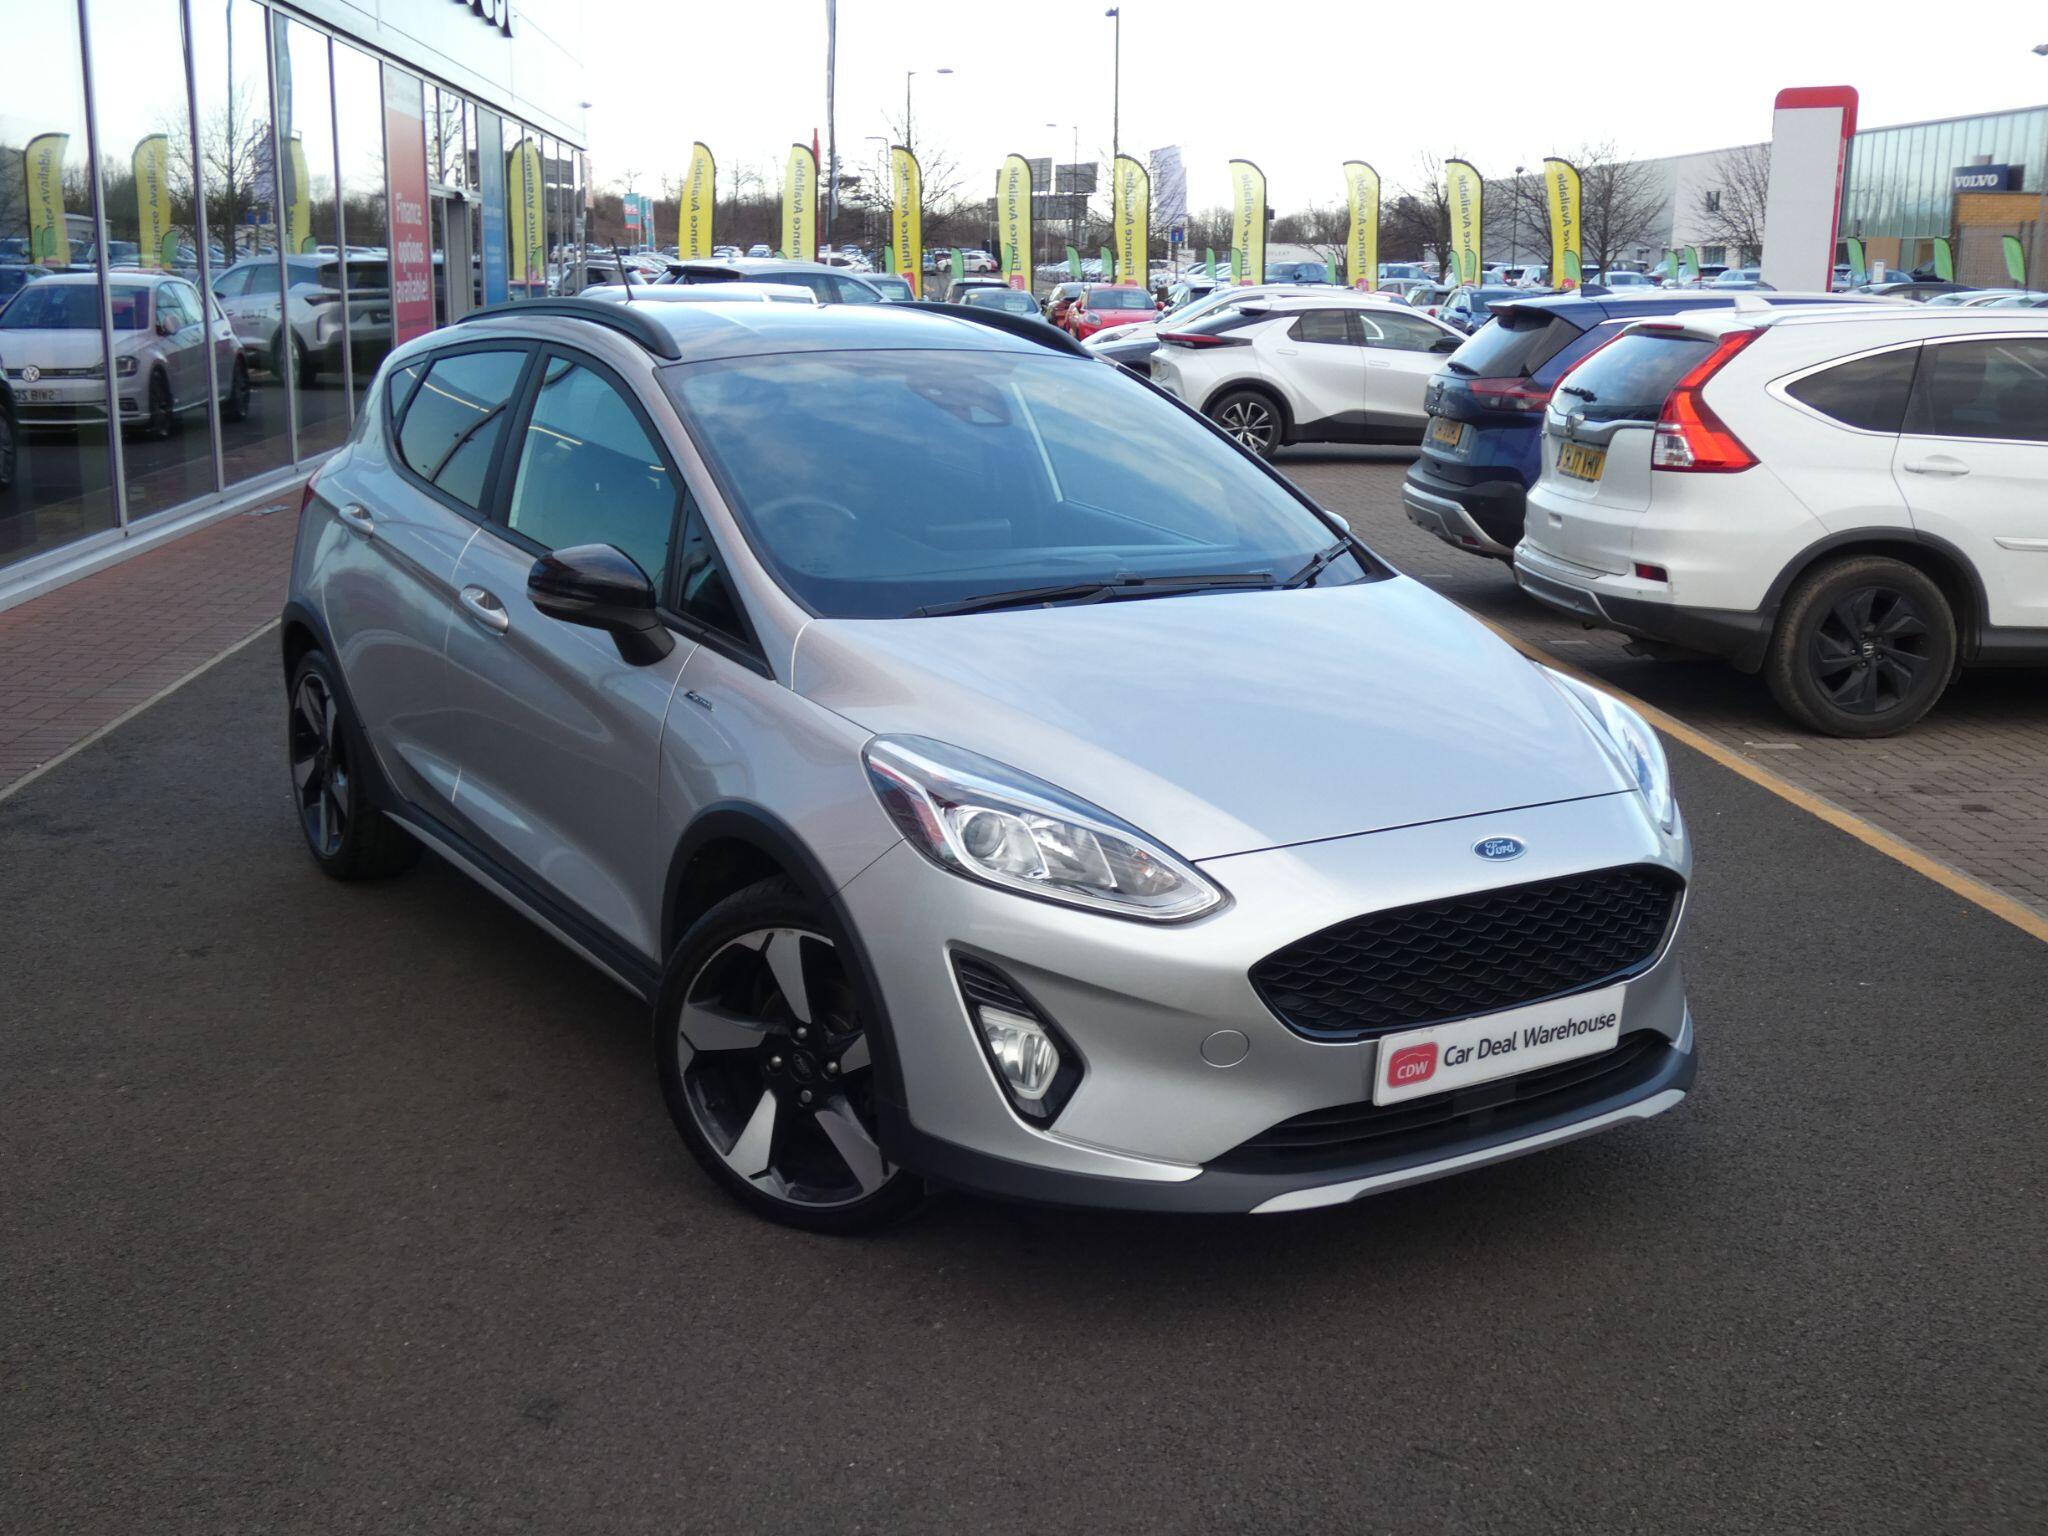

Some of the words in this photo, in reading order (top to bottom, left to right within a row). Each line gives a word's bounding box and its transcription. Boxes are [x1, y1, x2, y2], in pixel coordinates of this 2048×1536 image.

[1954, 174, 1999, 188] VOLVO
[395, 192, 422, 225] Finance
[398, 233, 424, 272] options
[396, 272, 430, 304] available!
[1484, 839, 1516, 857] Ford
[1444, 1045, 1473, 1067] Car
[1477, 1031, 1517, 1060] Deal
[1523, 1012, 1617, 1049] Warehouse
[1396, 1060, 1428, 1080] CDW
